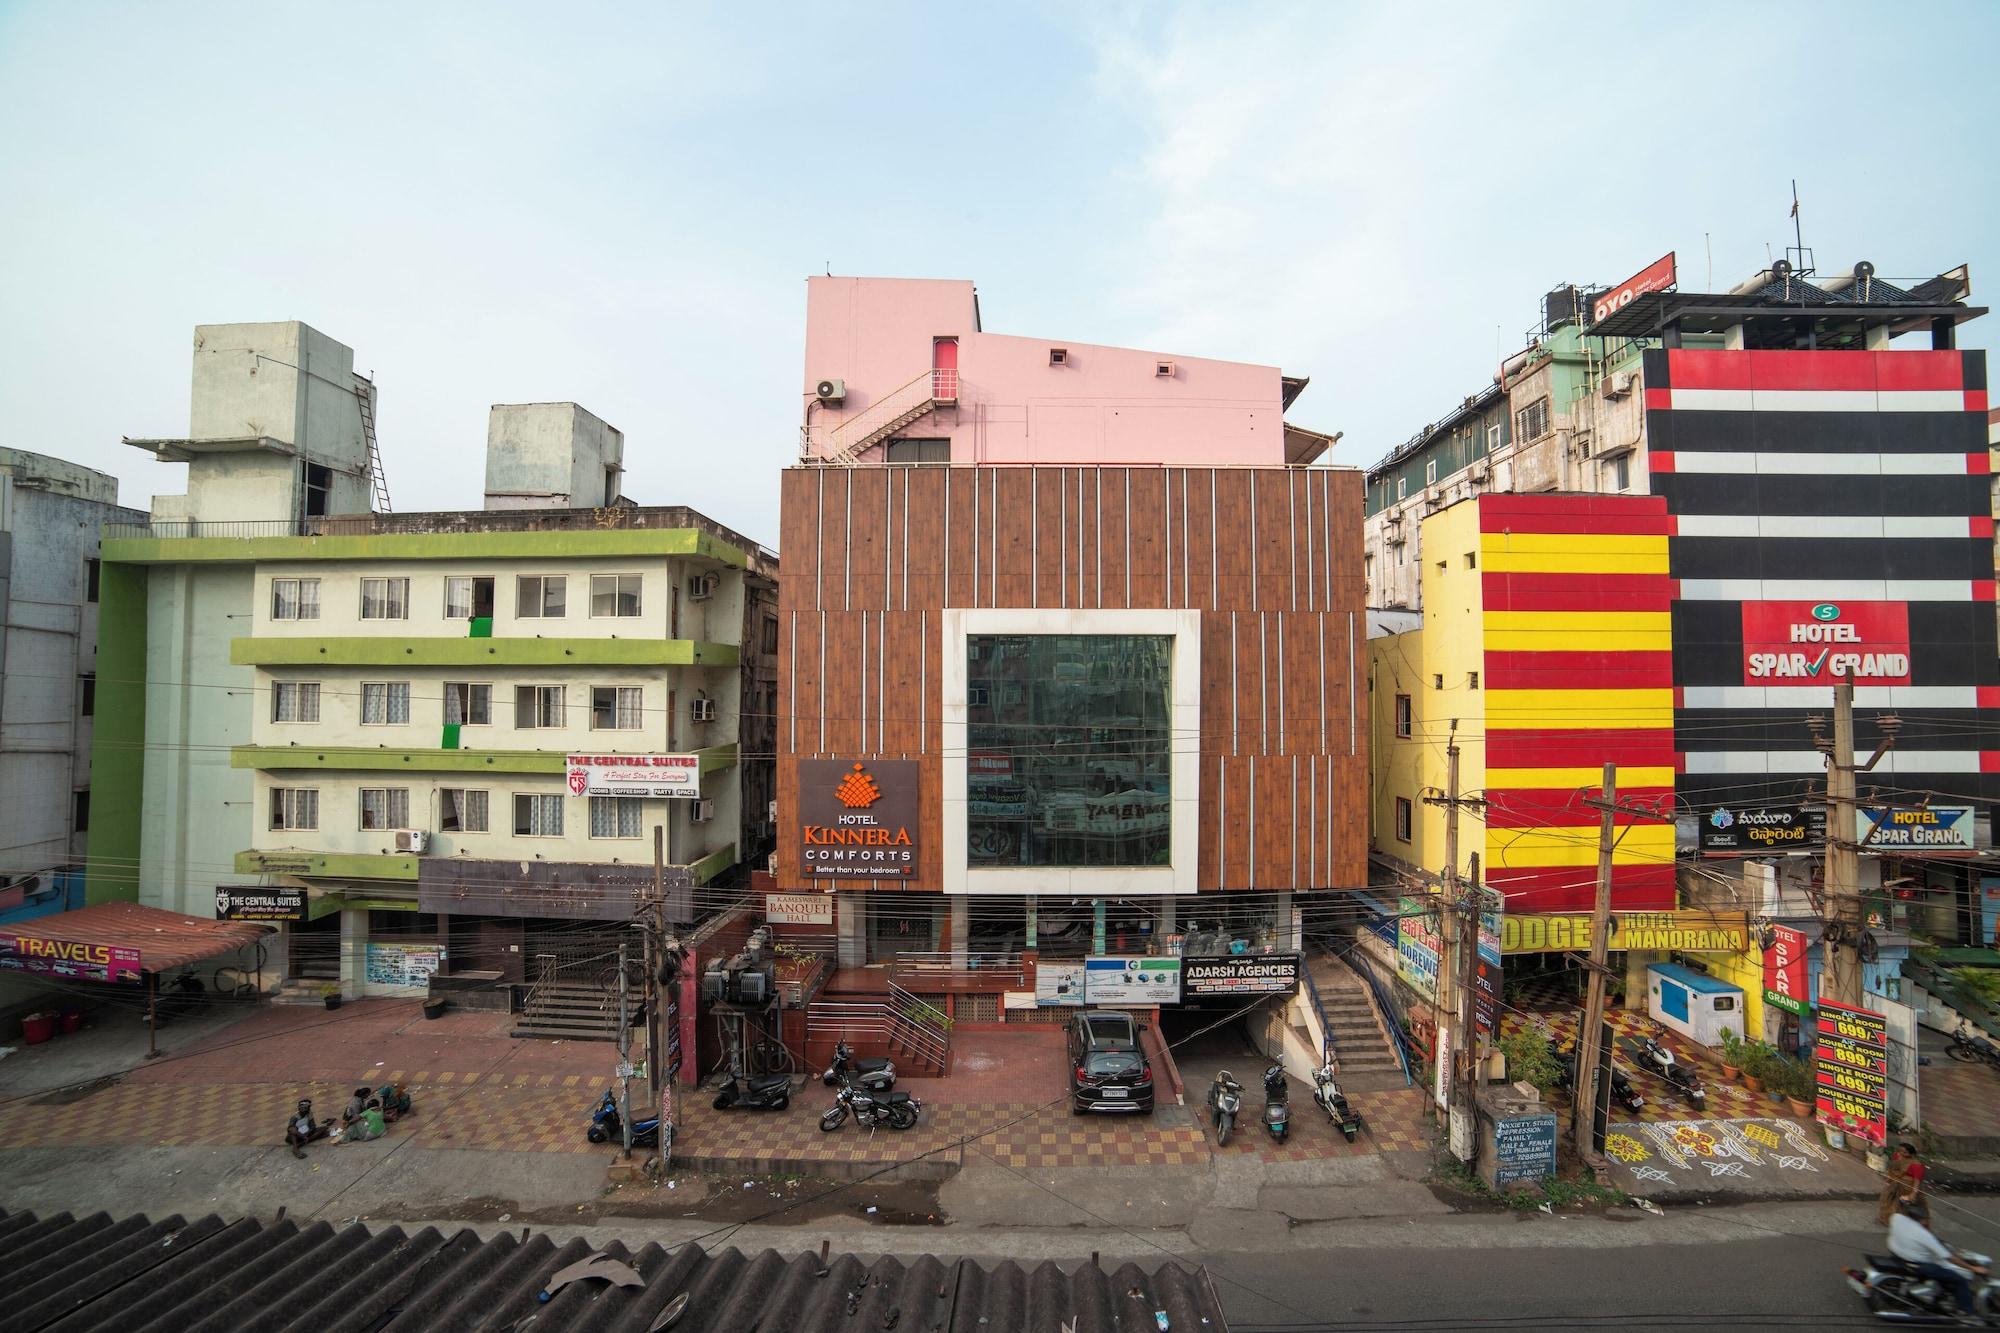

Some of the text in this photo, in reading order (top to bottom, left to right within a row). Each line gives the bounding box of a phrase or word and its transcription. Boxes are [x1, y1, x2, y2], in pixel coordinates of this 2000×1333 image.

[1595, 289, 1633, 322] OYO
[1791, 624, 1861, 642] HOTEL
[1749, 653, 1908, 677] SPAR GRAND
[567, 756, 697, 767] THE CENTRAL SUITES
[611, 771, 632, 780] Perfect
[633, 772, 648, 781] Stay
[838, 815, 878, 825] HOTEL
[1738, 810, 1792, 825] మయూరి
[1894, 812, 1939, 824] HOTEL
[803, 826, 913, 846] KINNERA
[1870, 825, 1963, 844] SPAR GRAND
[805, 850, 911, 860] COMFORTS
[853, 867, 868, 875] your
[870, 866, 900, 874] bedroom
[230, 897, 301, 906] THE CENTRAL SUITES
[770, 904, 829, 916] BANQUET
[1625, 912, 1675, 929] HOTEL
[1501, 916, 1592, 951] ODGE
[1625, 929, 1742, 949] MANORAMA
[1774, 929, 1796, 944] OTEL
[16, 936, 111, 965] TRAVELS
[1400, 940, 1439, 977] BOREWE
[1187, 965, 1295, 978] ADARSH AGENCIES
[1775, 942, 1789, 996] SPAR
[1476, 975, 1494, 993] OTEL
[1767, 990, 1800, 1010] GRAND
[1820, 1011, 1883, 1031] SINGLE ROOM
[1841, 1010, 1856, 1018] A/C
[1837, 1021, 1876, 1041] 699/-
[1819, 1037, 1884, 1059] DOUBLE ROOM
[1841, 1038, 1856, 1046] A/C
[1835, 1048, 1876, 1068] 899/-
[1818, 1062, 1884, 1084] SINGLE ROOM
[1836, 1074, 1876, 1095] 499/-
[1818, 1087, 1883, 1110] DOUBLE ROOM
[1835, 1099, 1876, 1120] 599/-
[1500, 1142, 1518, 1150] MALE
[1522, 1168, 1546, 1176] ABOUT
